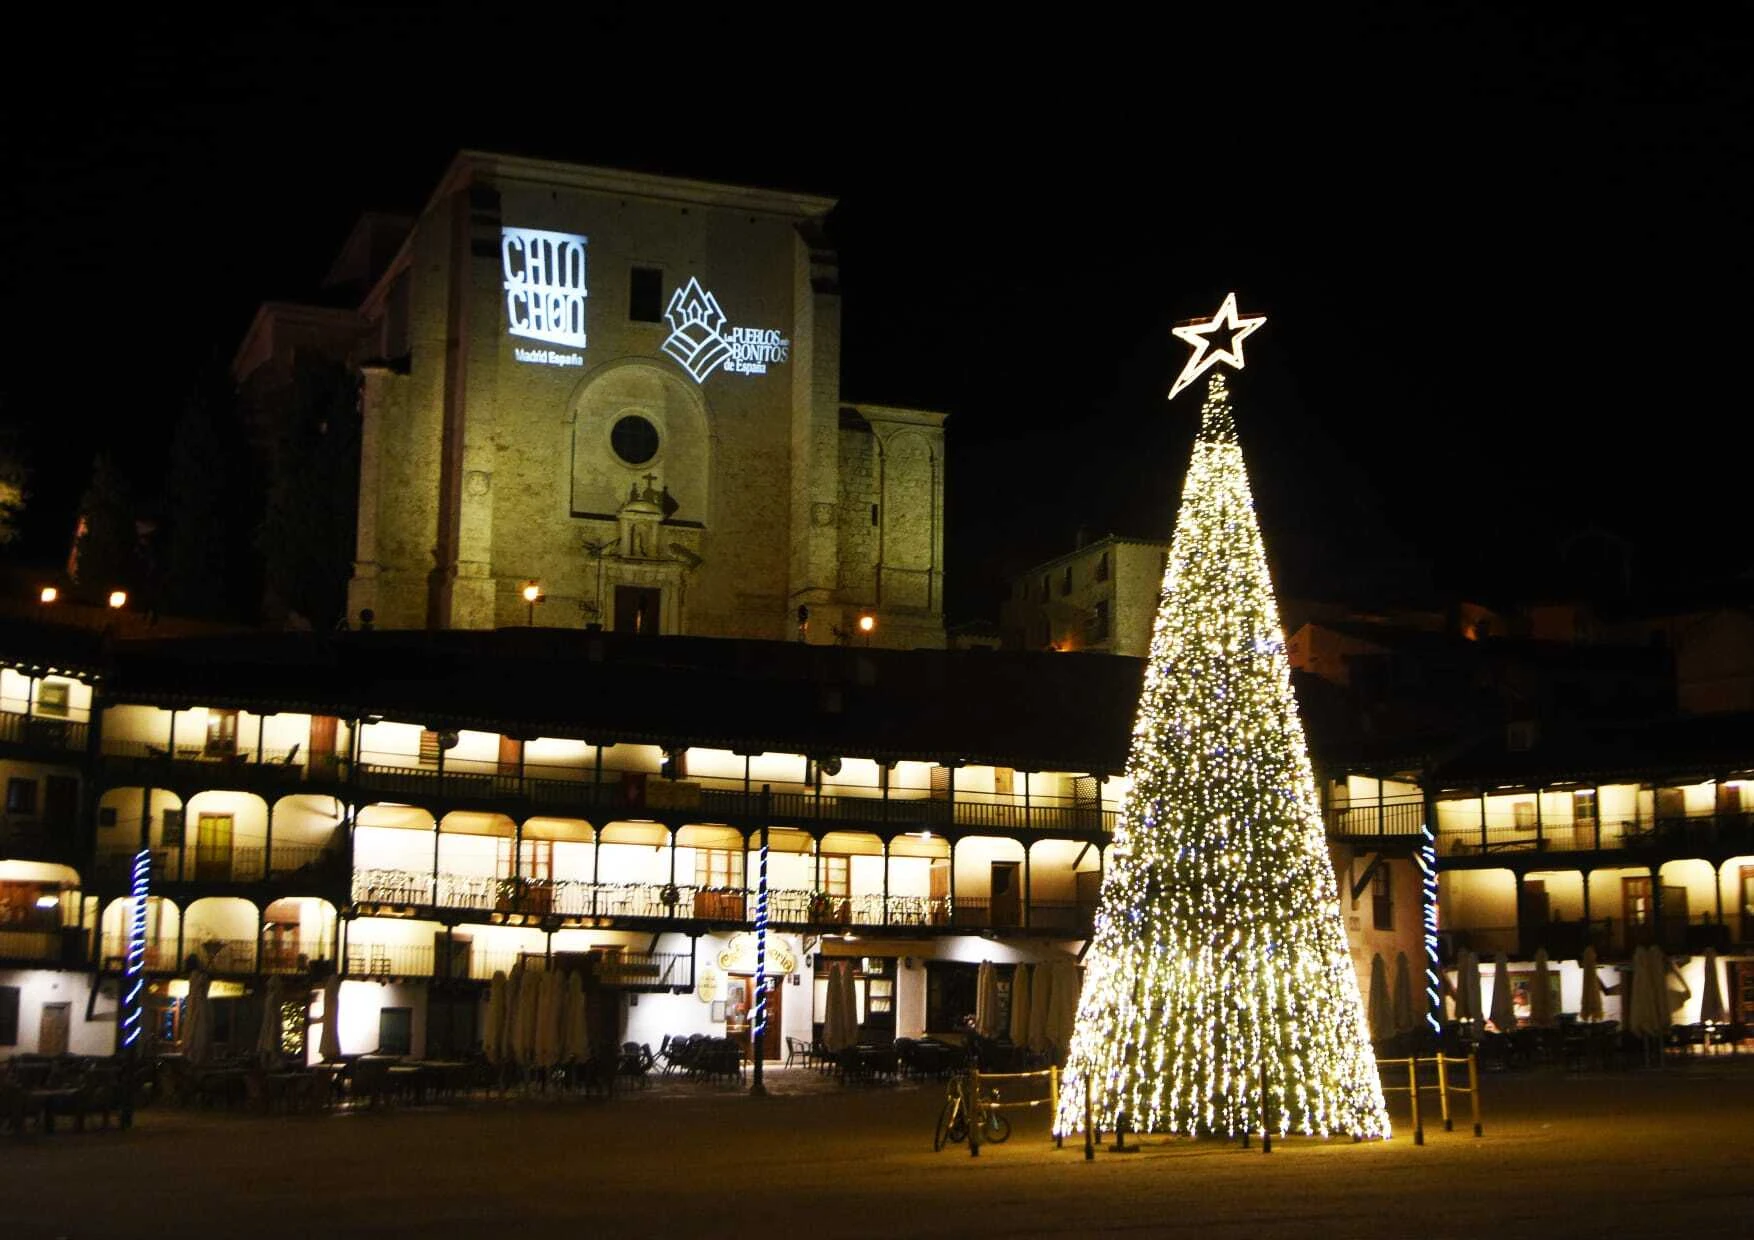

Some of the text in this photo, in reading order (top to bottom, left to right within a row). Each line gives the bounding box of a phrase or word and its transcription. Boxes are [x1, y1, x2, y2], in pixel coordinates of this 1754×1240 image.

[732, 327, 781, 346] PUEBLOS
[515, 348, 584, 367] Madrid España
[732, 343, 789, 363] BONITOS
[723, 358, 735, 371] de
